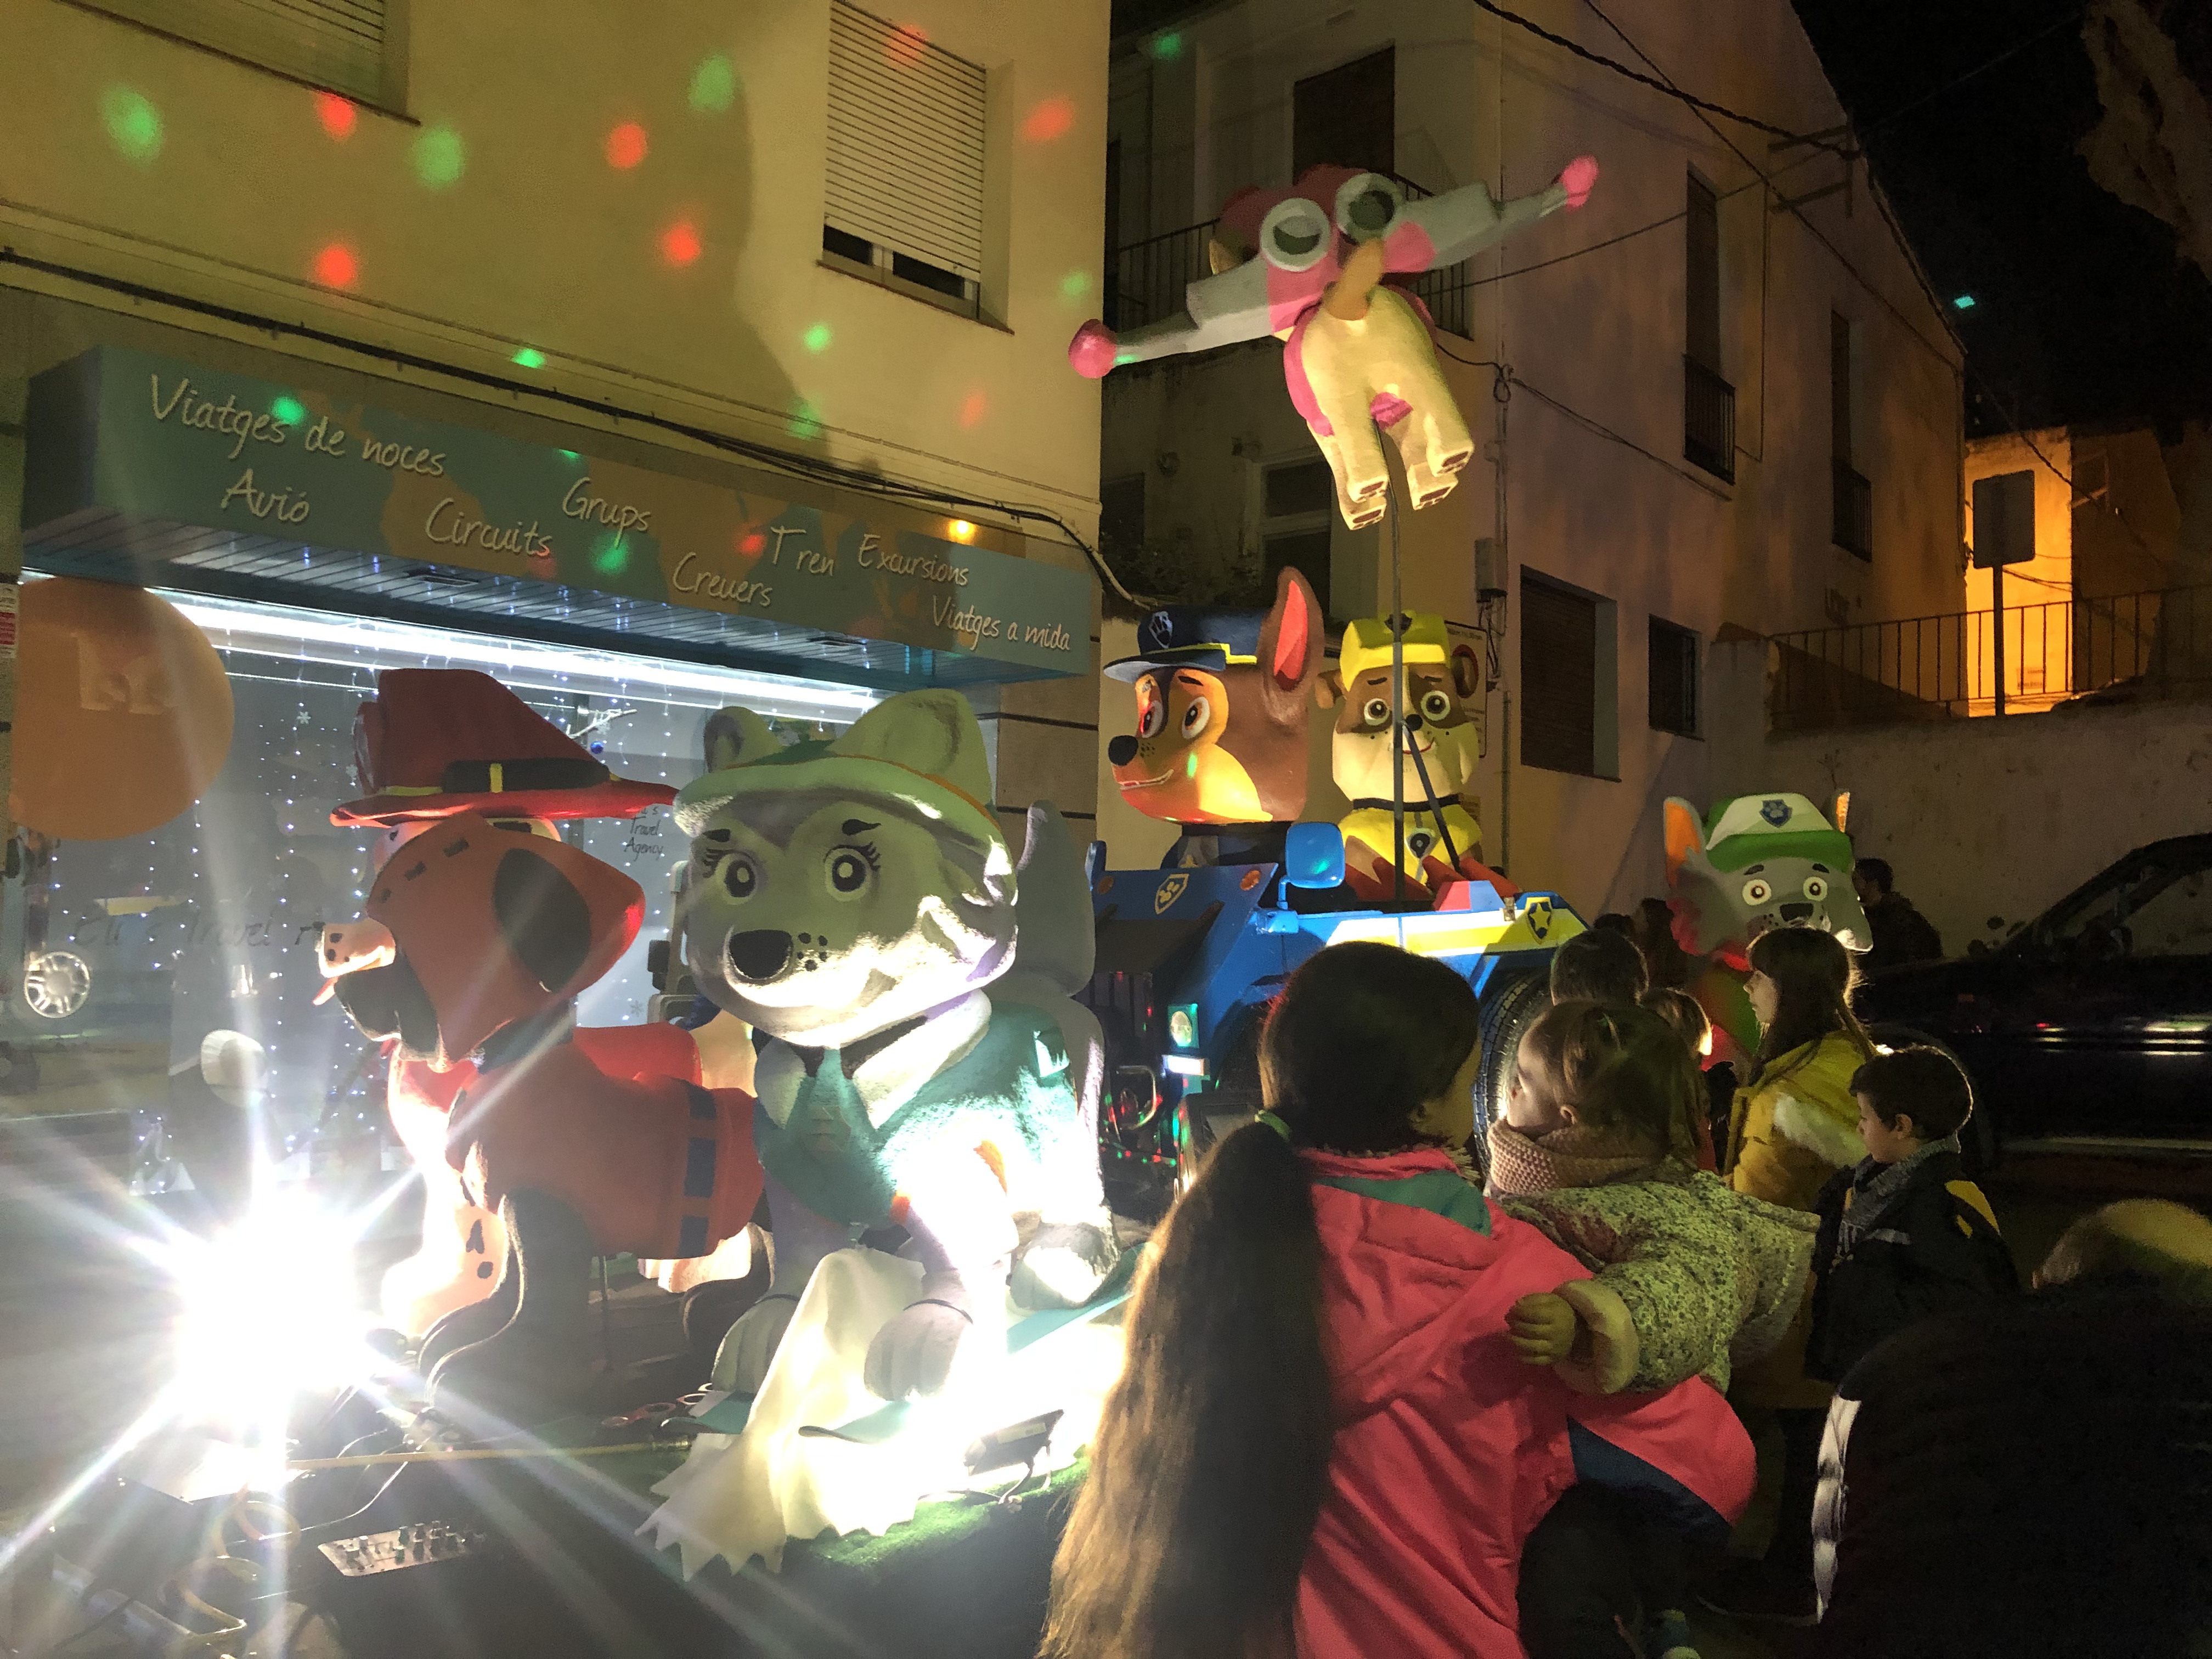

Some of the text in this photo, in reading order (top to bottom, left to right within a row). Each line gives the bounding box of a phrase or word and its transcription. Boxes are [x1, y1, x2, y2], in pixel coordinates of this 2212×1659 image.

[150, 374, 447, 476] Viatges de noces
[220, 468, 310, 522] Avió
[561, 476, 652, 549] Grups
[424, 497, 553, 557] Circuits
[770, 525, 836, 577] Tren
[673, 552, 773, 607] Creuers
[857, 533, 970, 586] Excursions
[933, 595, 1071, 651] Viatges a mida
